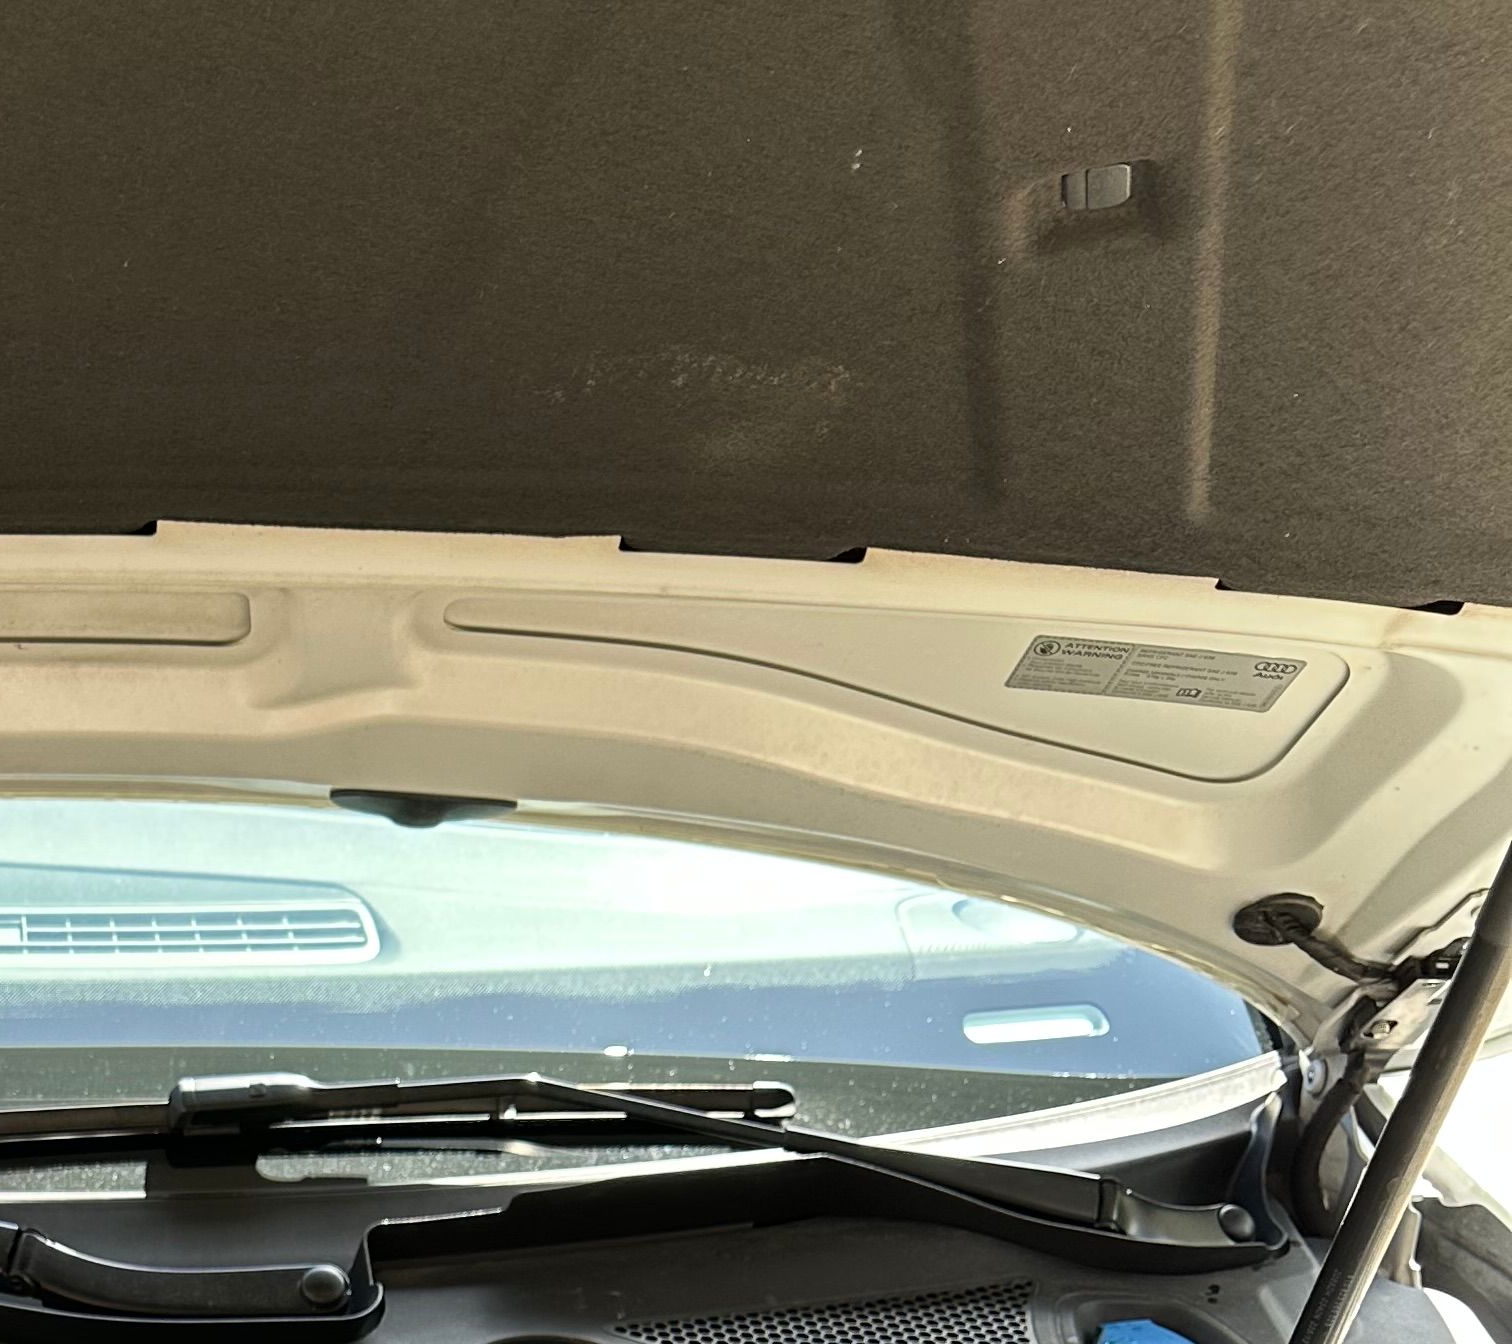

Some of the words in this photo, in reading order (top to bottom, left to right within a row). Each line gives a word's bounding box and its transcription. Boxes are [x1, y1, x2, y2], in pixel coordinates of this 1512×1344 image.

[1065, 642, 1130, 654] ATTENTION
[1062, 650, 1124, 660] WARNING
[1253, 672, 1284, 680] Audi
